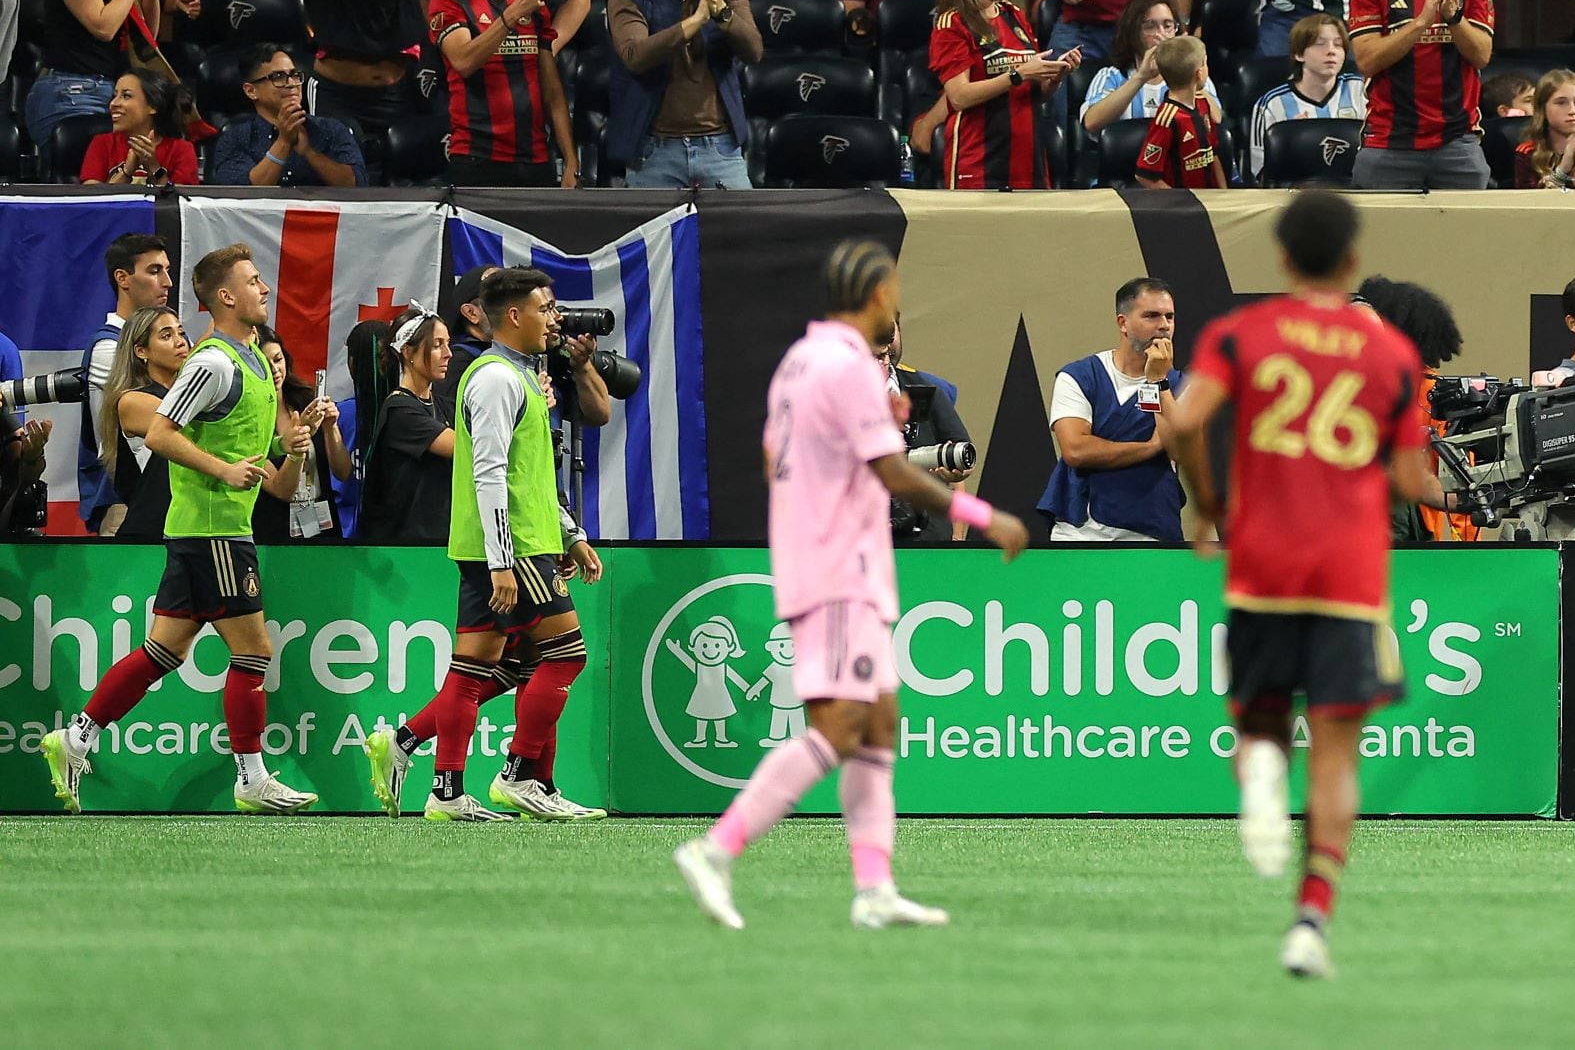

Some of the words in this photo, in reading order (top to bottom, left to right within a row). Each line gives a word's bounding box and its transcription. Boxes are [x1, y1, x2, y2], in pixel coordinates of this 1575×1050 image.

[1249, 353, 1380, 471] 26
[1494, 621, 1522, 638] SM
[261, 712, 316, 756] of
[900, 714, 1190, 759] Healthcare
